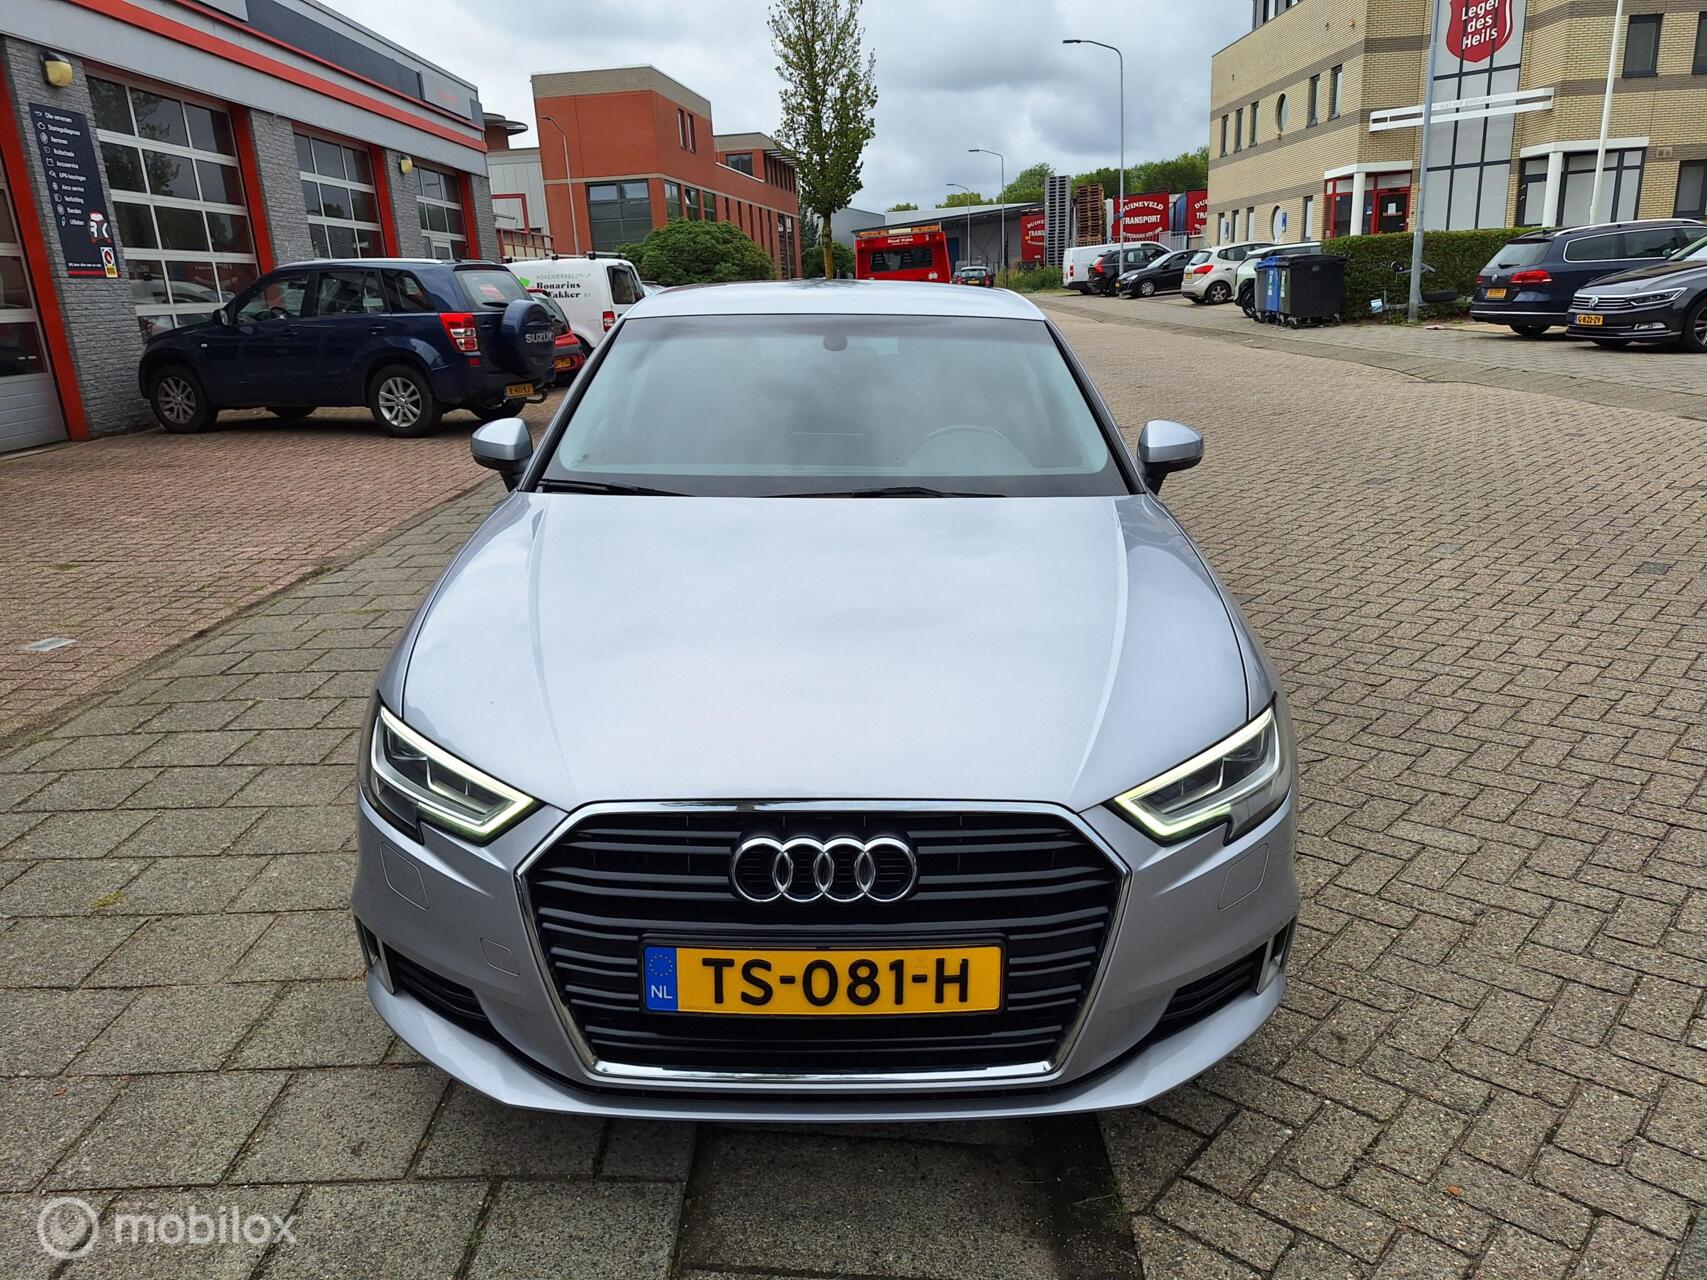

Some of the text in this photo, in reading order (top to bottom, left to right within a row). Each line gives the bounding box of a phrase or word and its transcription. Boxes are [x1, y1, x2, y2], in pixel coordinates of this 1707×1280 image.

[1467, 15, 1493, 33] des
[1462, 28, 1498, 50] Heils
[536, 281, 581, 289] Bonarius
[702, 957, 969, 1006] TS-081-H
[650, 984, 673, 999] NL
